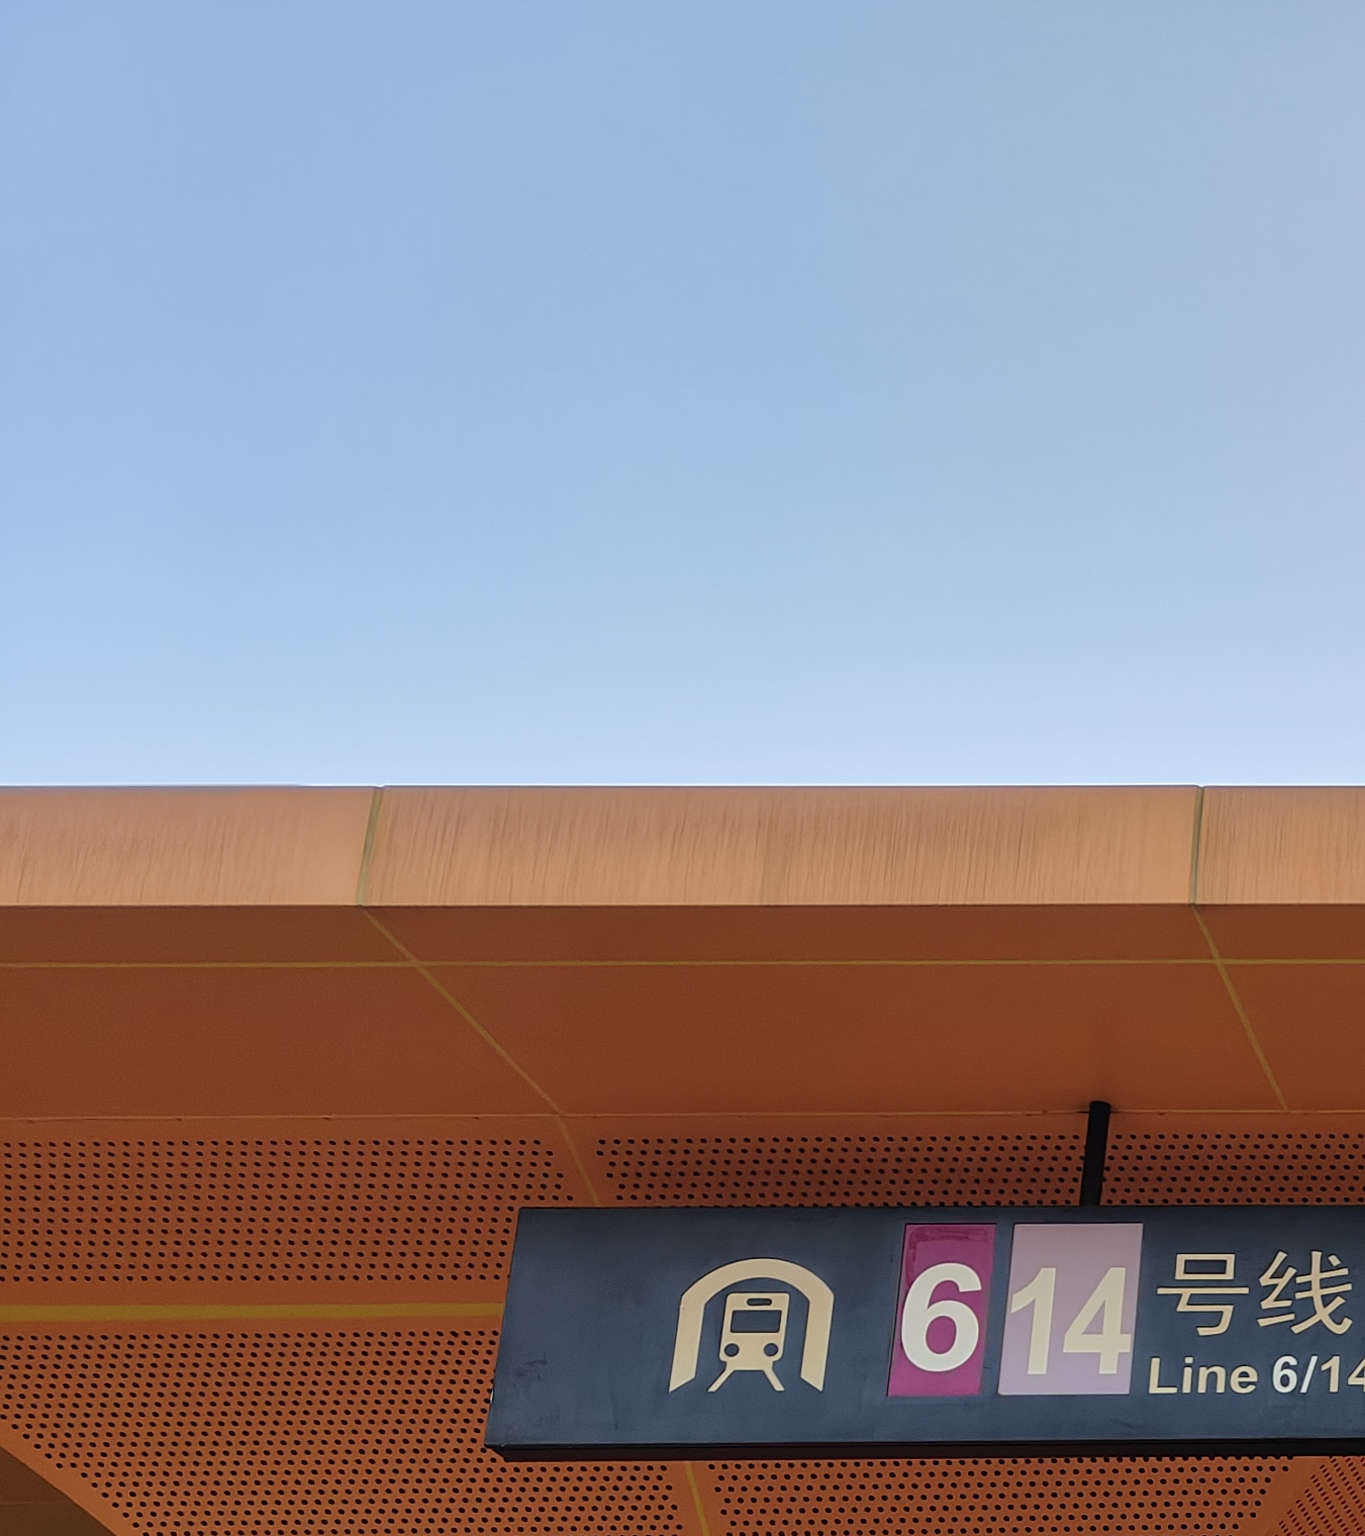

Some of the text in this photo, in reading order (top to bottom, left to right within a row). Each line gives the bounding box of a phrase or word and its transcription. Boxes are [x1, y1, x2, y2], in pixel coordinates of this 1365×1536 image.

[901, 1250, 1353, 1375] 6 14 号线
[1148, 1356, 1258, 1394] Line
